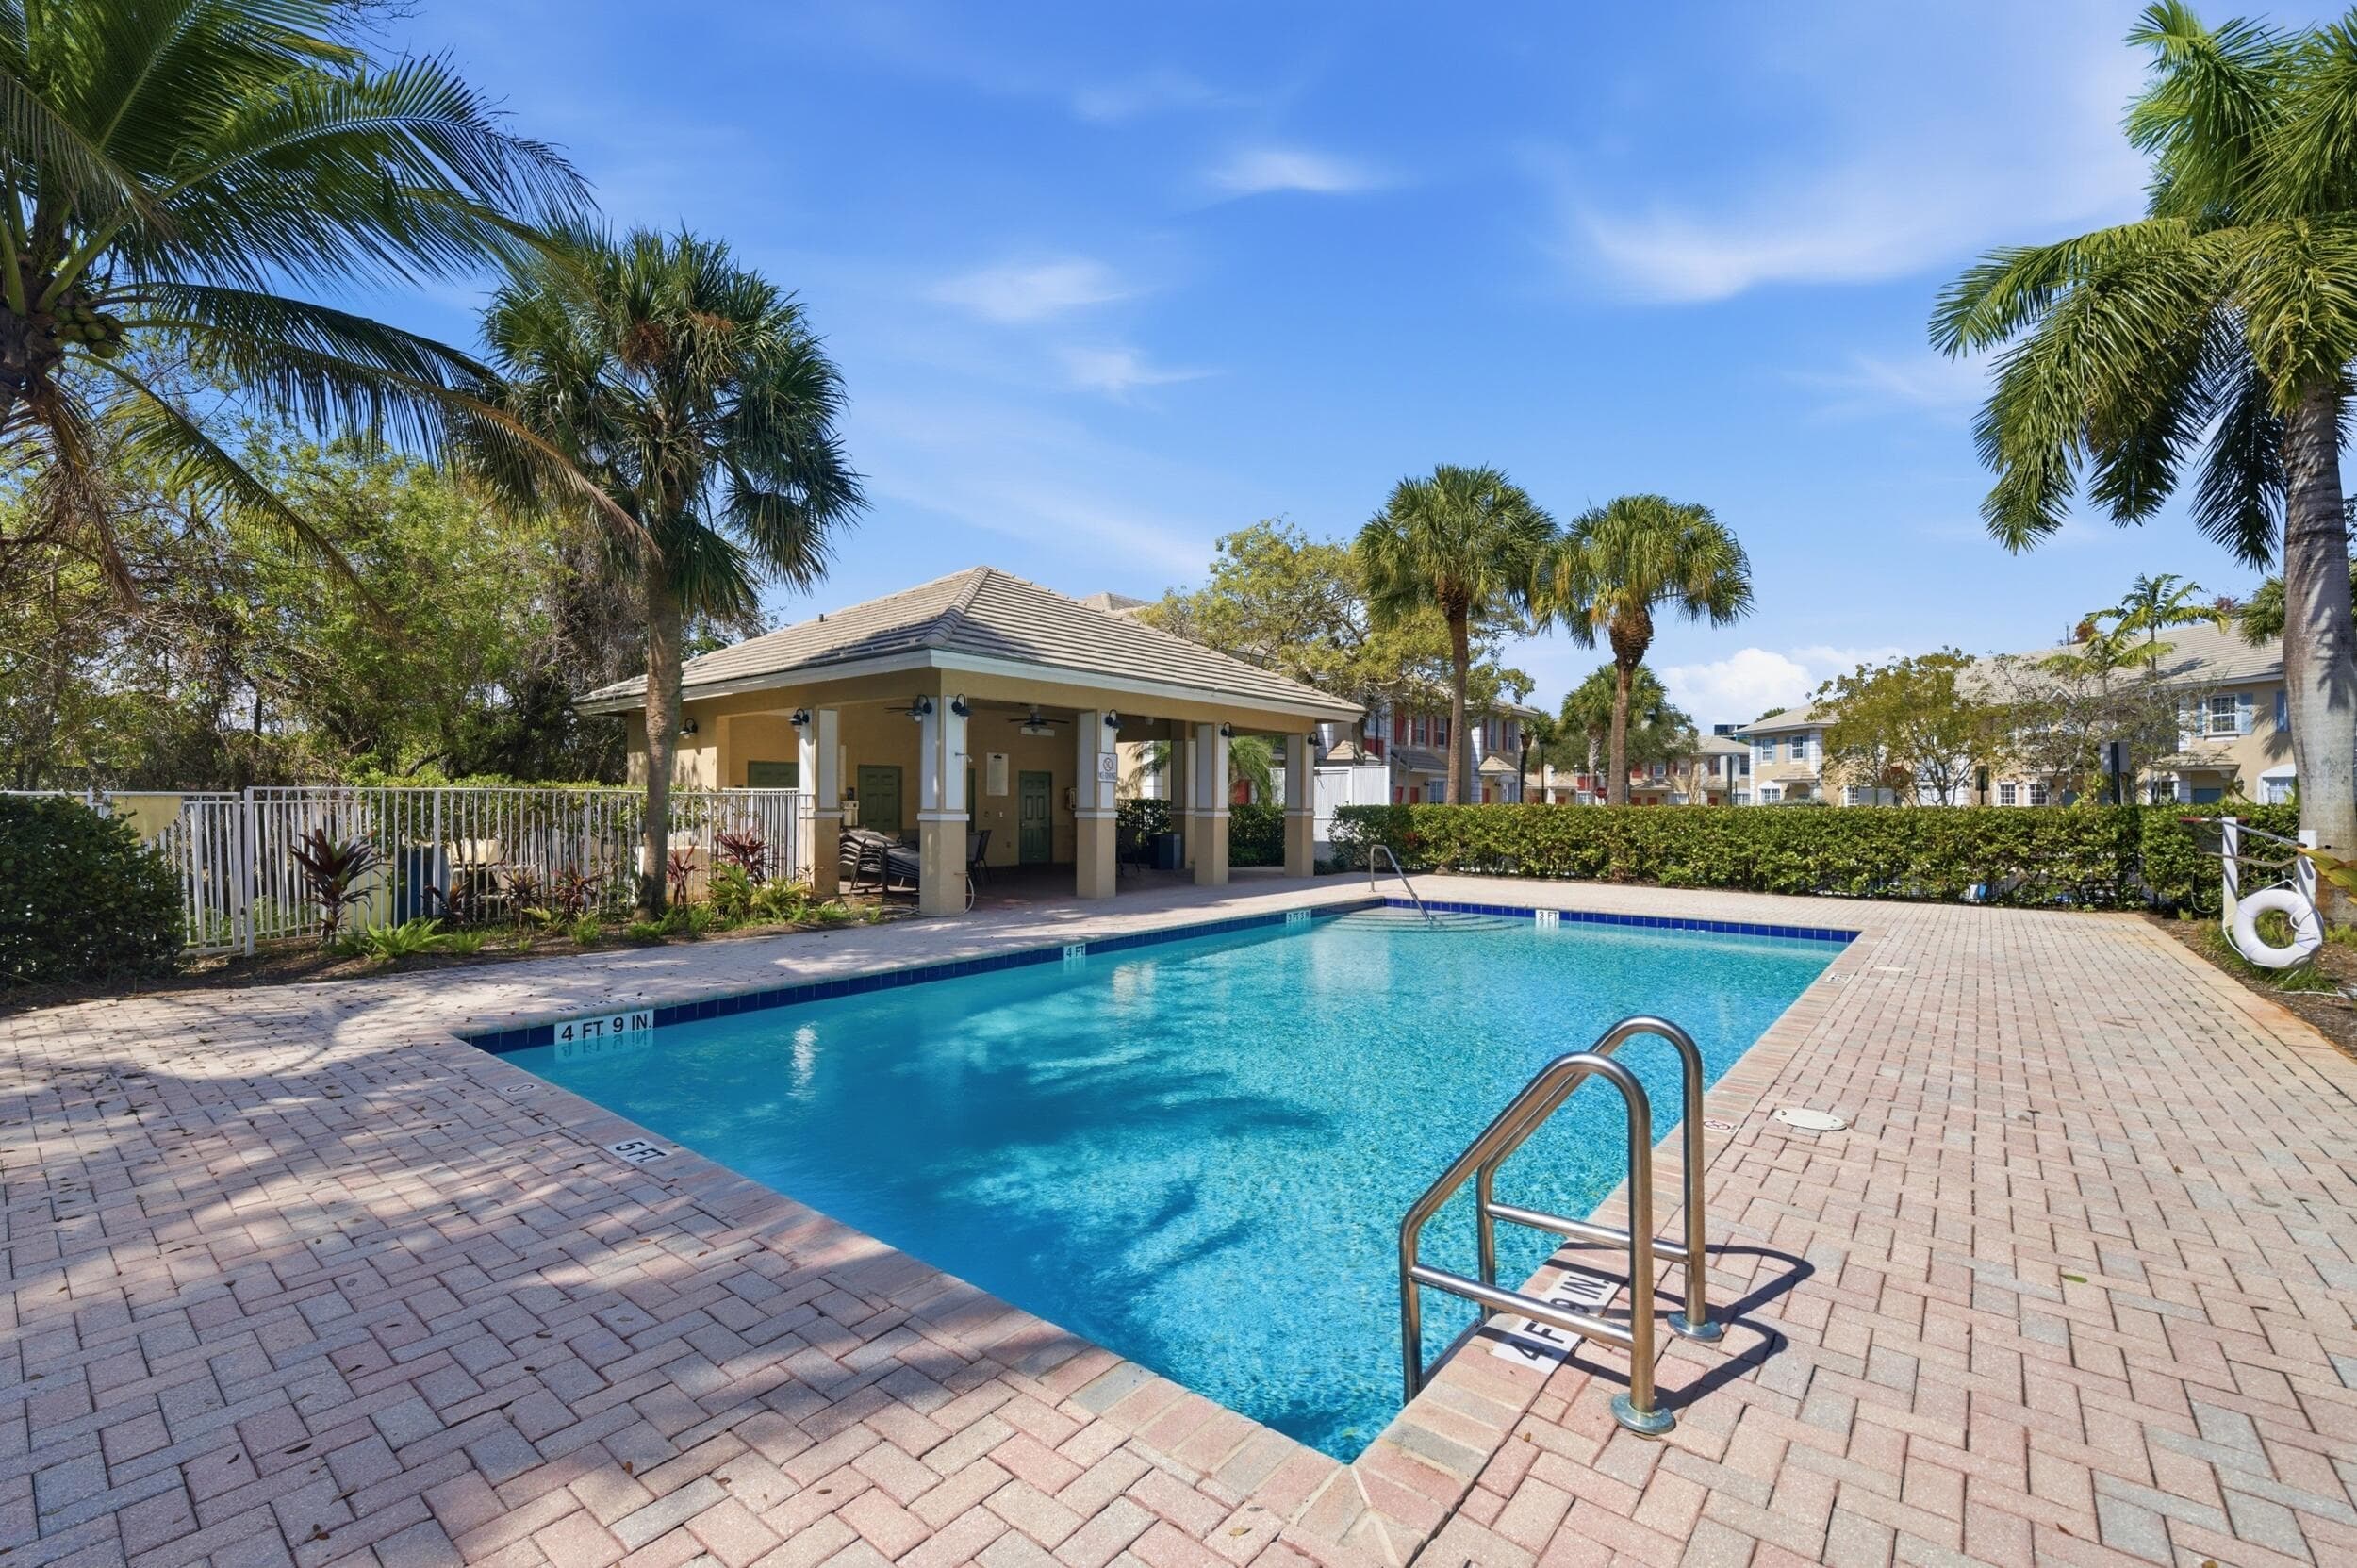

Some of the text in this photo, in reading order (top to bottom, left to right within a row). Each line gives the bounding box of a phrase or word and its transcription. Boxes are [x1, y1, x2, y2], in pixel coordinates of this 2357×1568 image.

[1539, 911, 1558, 920] 3 FT
[1066, 947, 1072, 958] 4
[561, 1025, 573, 1041] 4
[613, 1016, 623, 1033] 9
[631, 1013, 651, 1031] IN.
[616, 1141, 646, 1151] 5
[1509, 1340, 1553, 1361] 4
